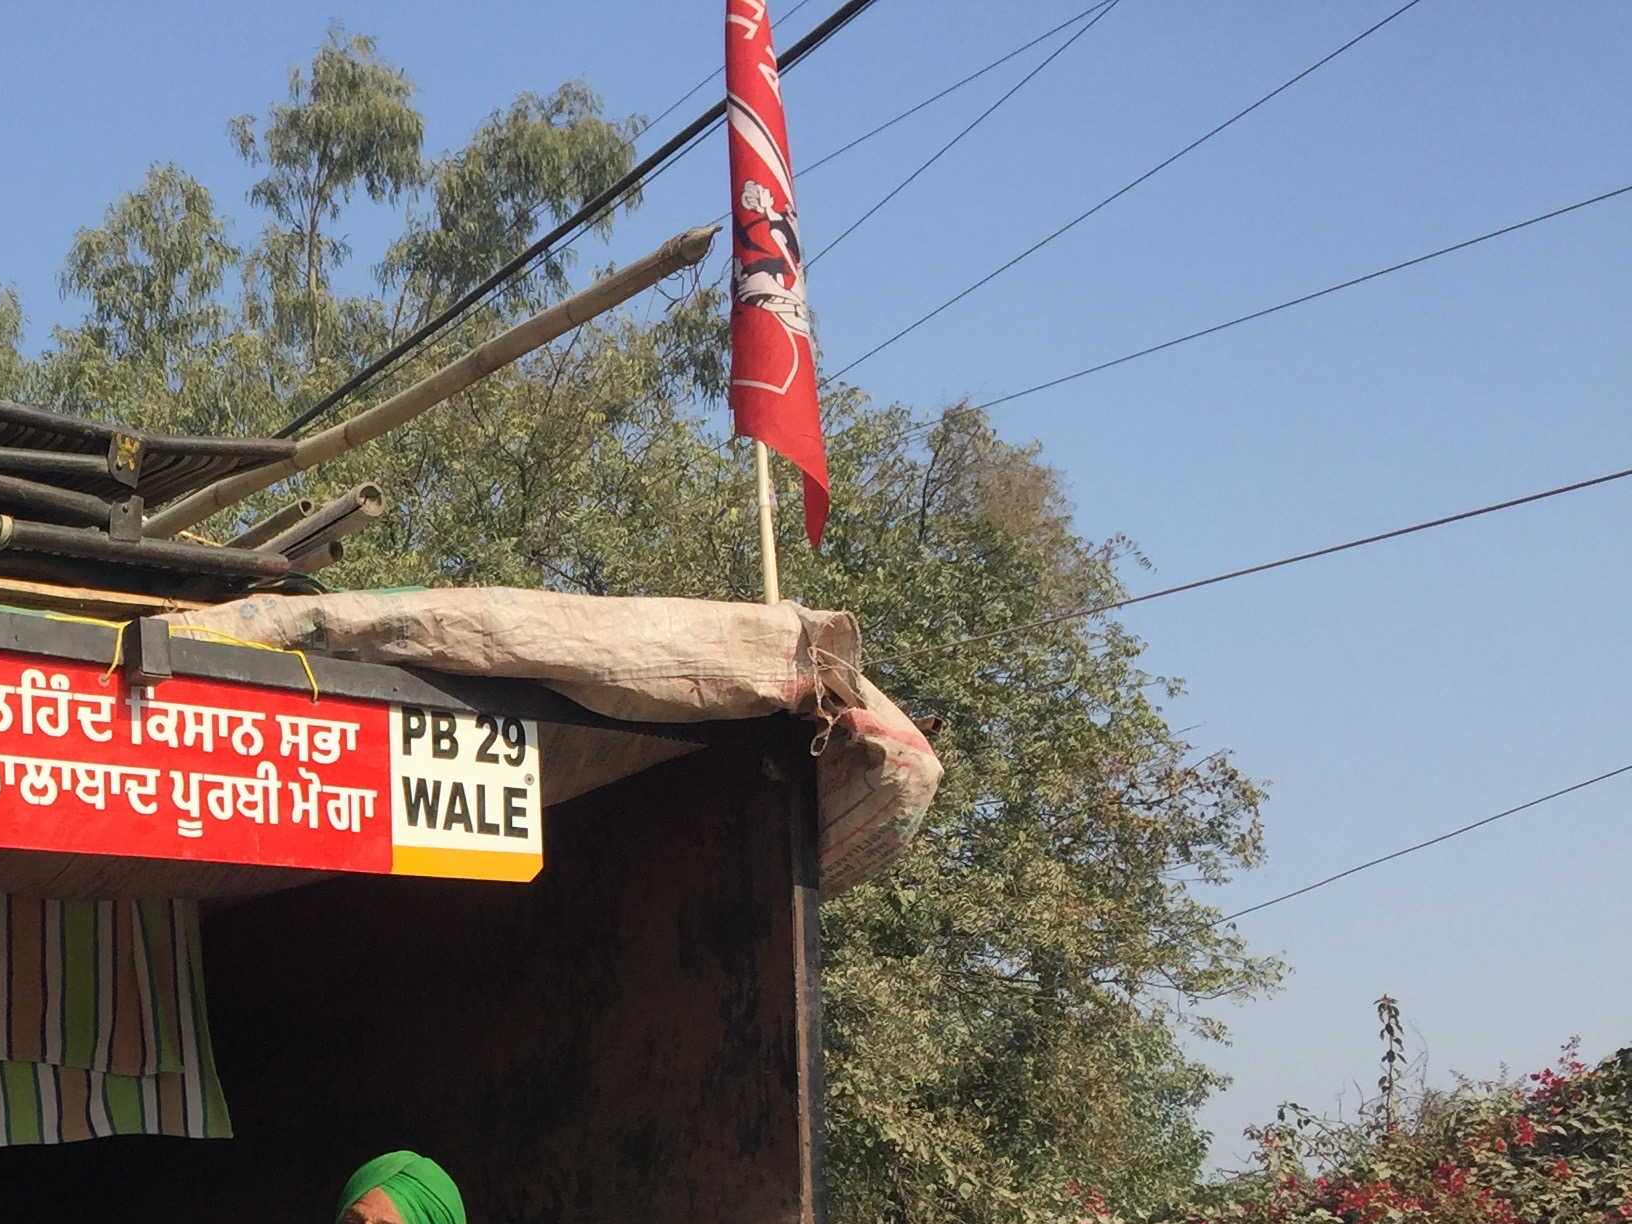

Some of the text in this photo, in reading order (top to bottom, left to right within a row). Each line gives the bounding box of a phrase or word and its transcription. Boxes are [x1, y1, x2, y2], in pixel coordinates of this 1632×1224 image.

[125, 686, 266, 756] ਕਿਸਾਨ
[275, 714, 360, 764] ਸਭਾ
[401, 705, 526, 767] PB 29
[170, 761, 282, 838] ਪੂਰਬੀ
[288, 767, 378, 832] ਮੋਗਾ
[401, 775, 529, 839] WALE
